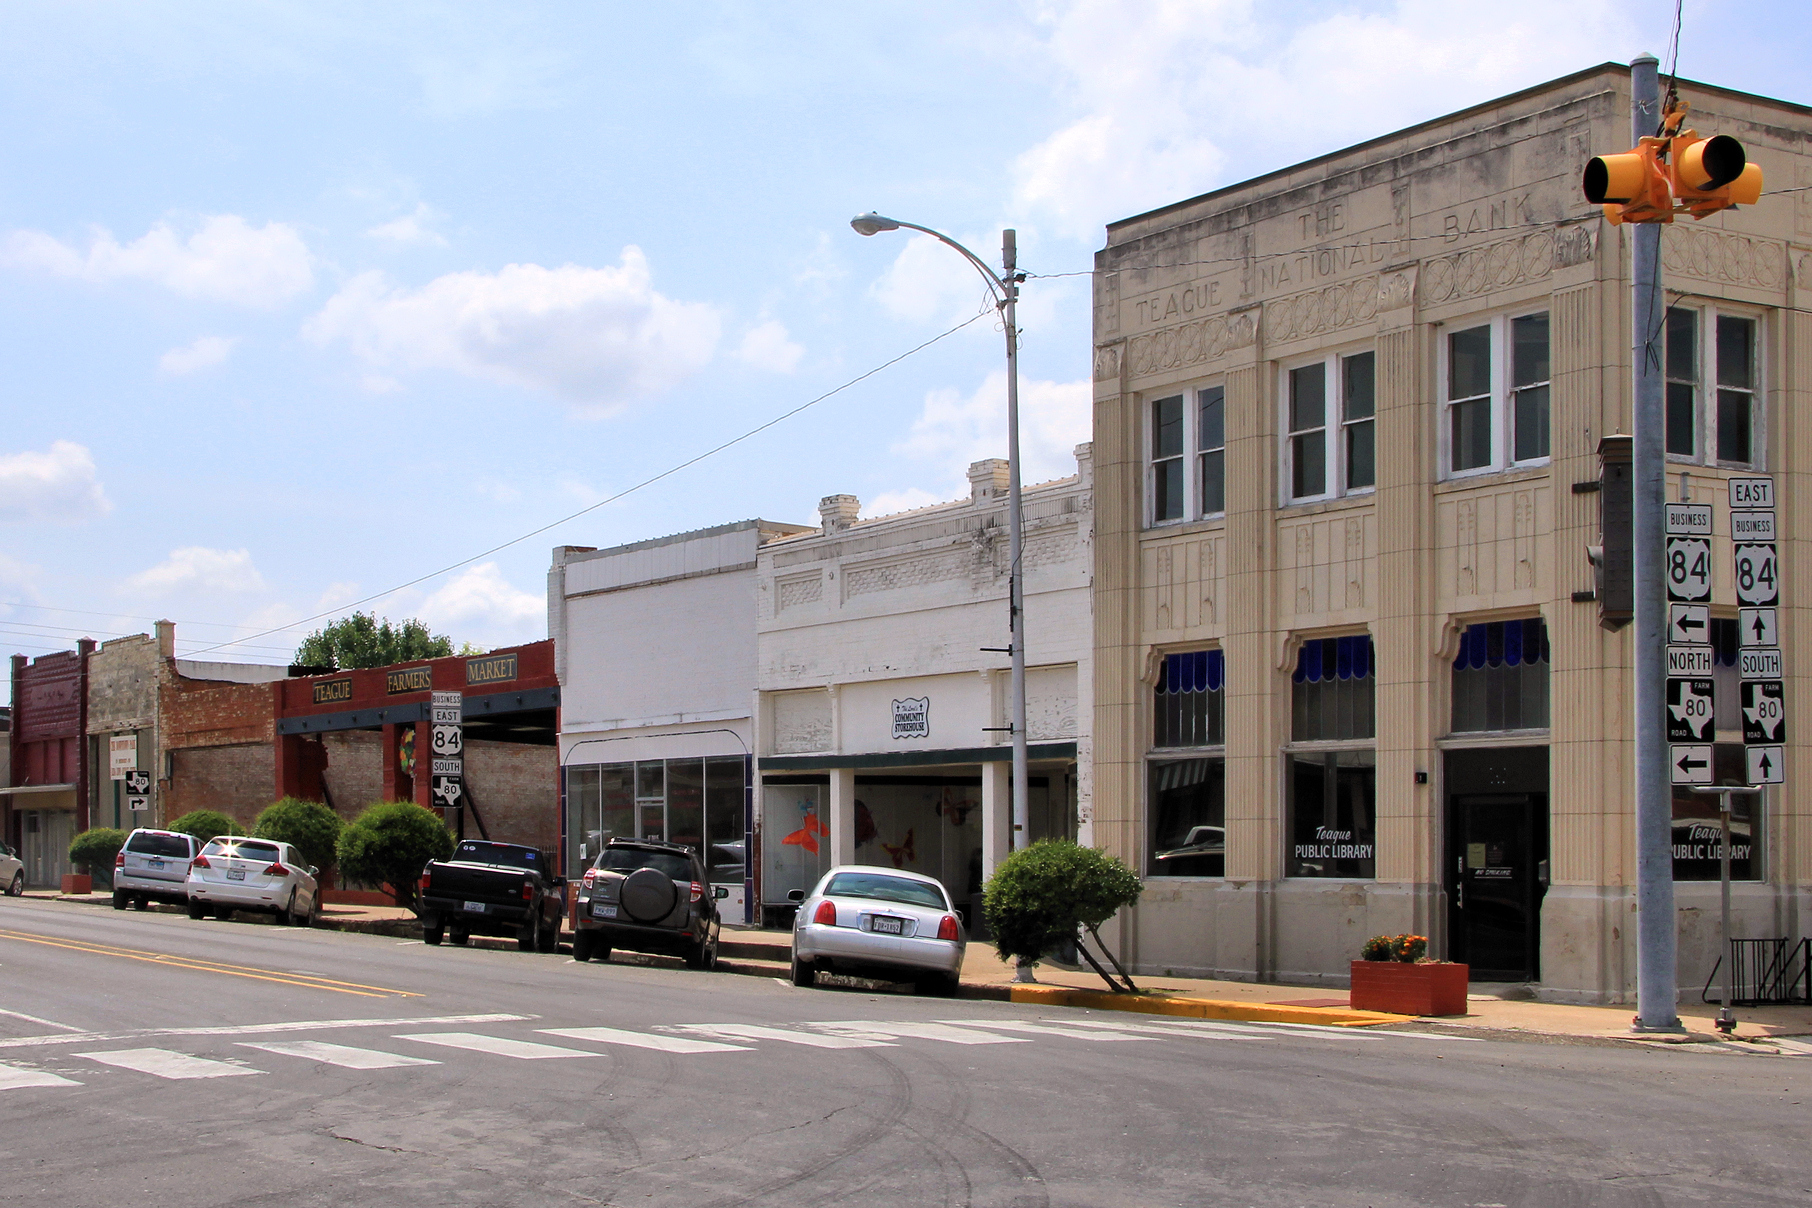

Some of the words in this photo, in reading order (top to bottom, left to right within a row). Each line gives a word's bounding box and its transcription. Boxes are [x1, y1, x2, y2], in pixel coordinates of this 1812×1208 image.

[1298, 204, 1345, 240] THE
[1136, 281, 1221, 325] TEAGUE
[1261, 238, 1384, 293] NATIONAL
[1444, 193, 1530, 244] BANK
[1736, 484, 1767, 501] EAST
[1670, 513, 1707, 526] BUSINESS
[1736, 520, 1770, 532] BUSINESS
[1671, 550, 1707, 584] 84
[1739, 557, 1774, 591] 84
[1669, 652, 1710, 670] NORTH
[1742, 655, 1778, 673] SOUTH
[314, 681, 350, 702] TEAGUE
[387, 670, 431, 692] FARMERS
[468, 658, 515, 682] MARKET
[433, 695, 460, 704] BUSINESS
[1685, 699, 1706, 716] 80
[436, 711, 457, 720] EAST
[895, 712, 924, 722] COMMUNITY
[1759, 701, 1777, 718] 80
[895, 722, 924, 732] STOREHOUSE
[434, 731, 459, 748] 84
[434, 762, 460, 772] SOUTH
[444, 785, 457, 794] 80
[1316, 825, 1352, 844] Teague
[1689, 823, 1722, 844] Teagu
[1295, 844, 1330, 858] PUBLIC
[1332, 844, 1373, 858] LIBRARY
[1672, 844, 1704, 859] UBLIC
[1707, 845, 1751, 859] LIBARY
